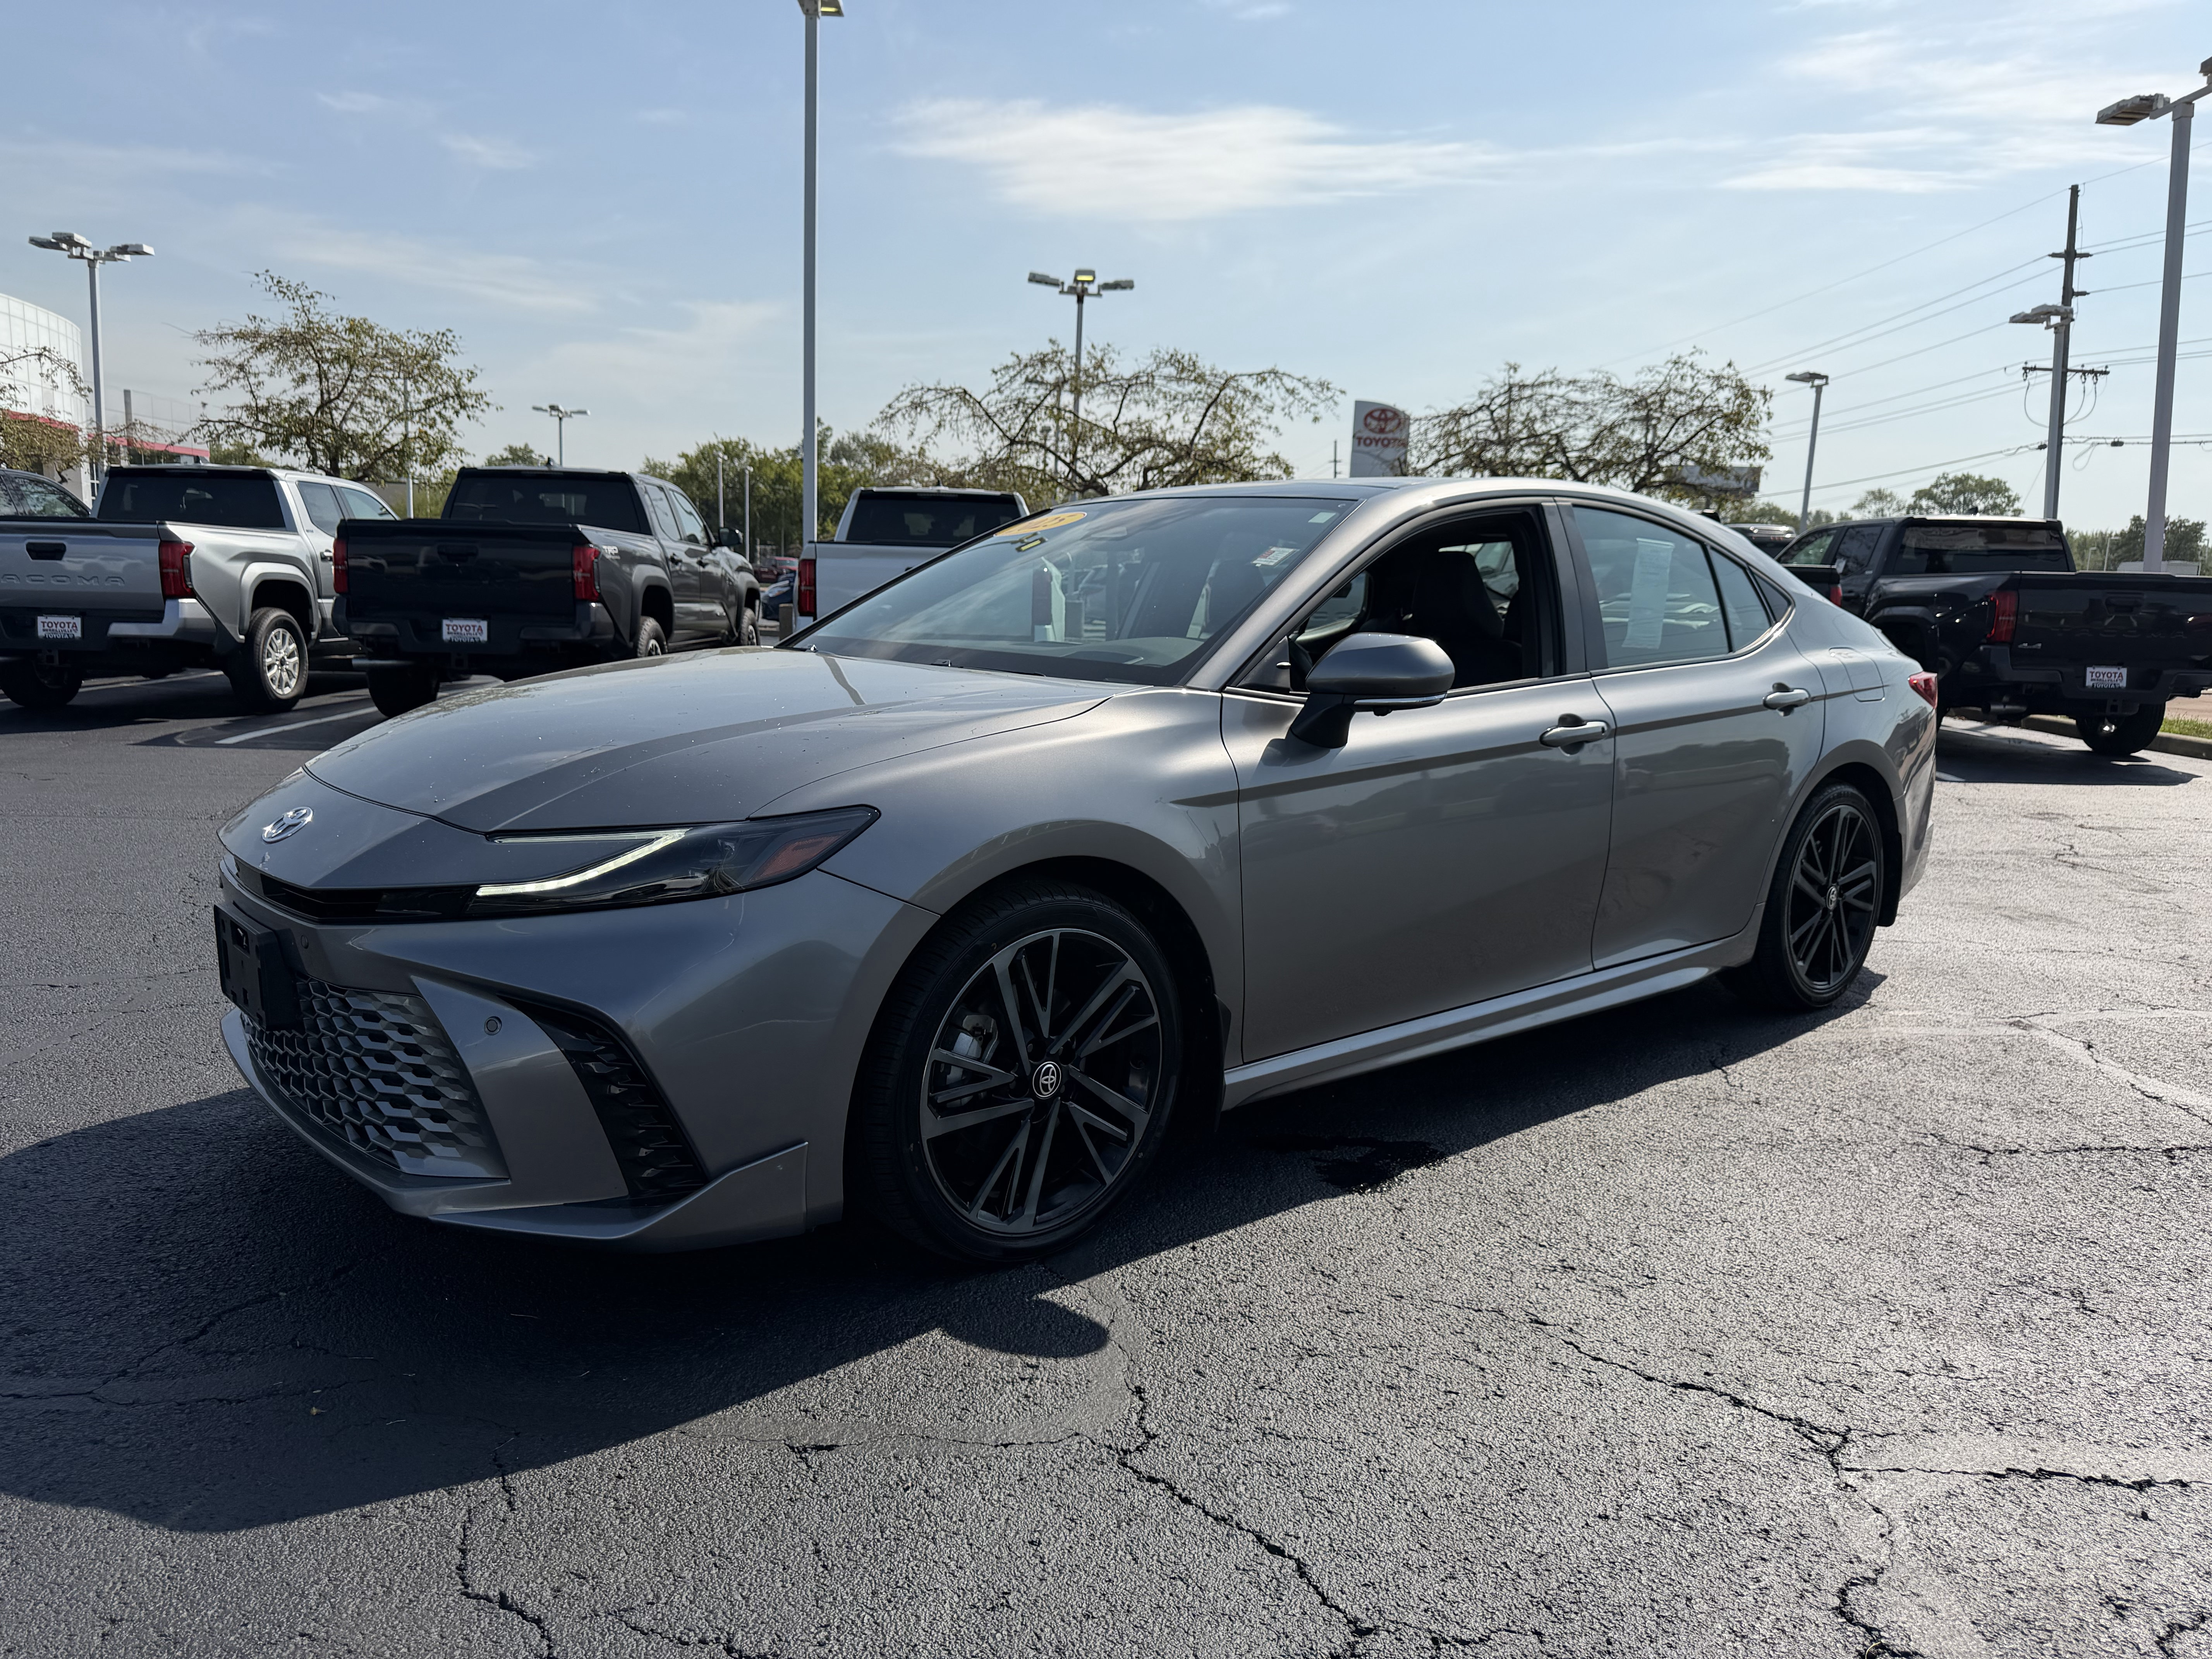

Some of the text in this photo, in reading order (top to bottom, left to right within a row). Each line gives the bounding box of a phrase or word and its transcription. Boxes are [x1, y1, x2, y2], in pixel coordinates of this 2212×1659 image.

[1, 574, 125, 586] ACOMA
[446, 624, 483, 632] TOYOTA
[2089, 671, 2123, 679] TOYOTA
